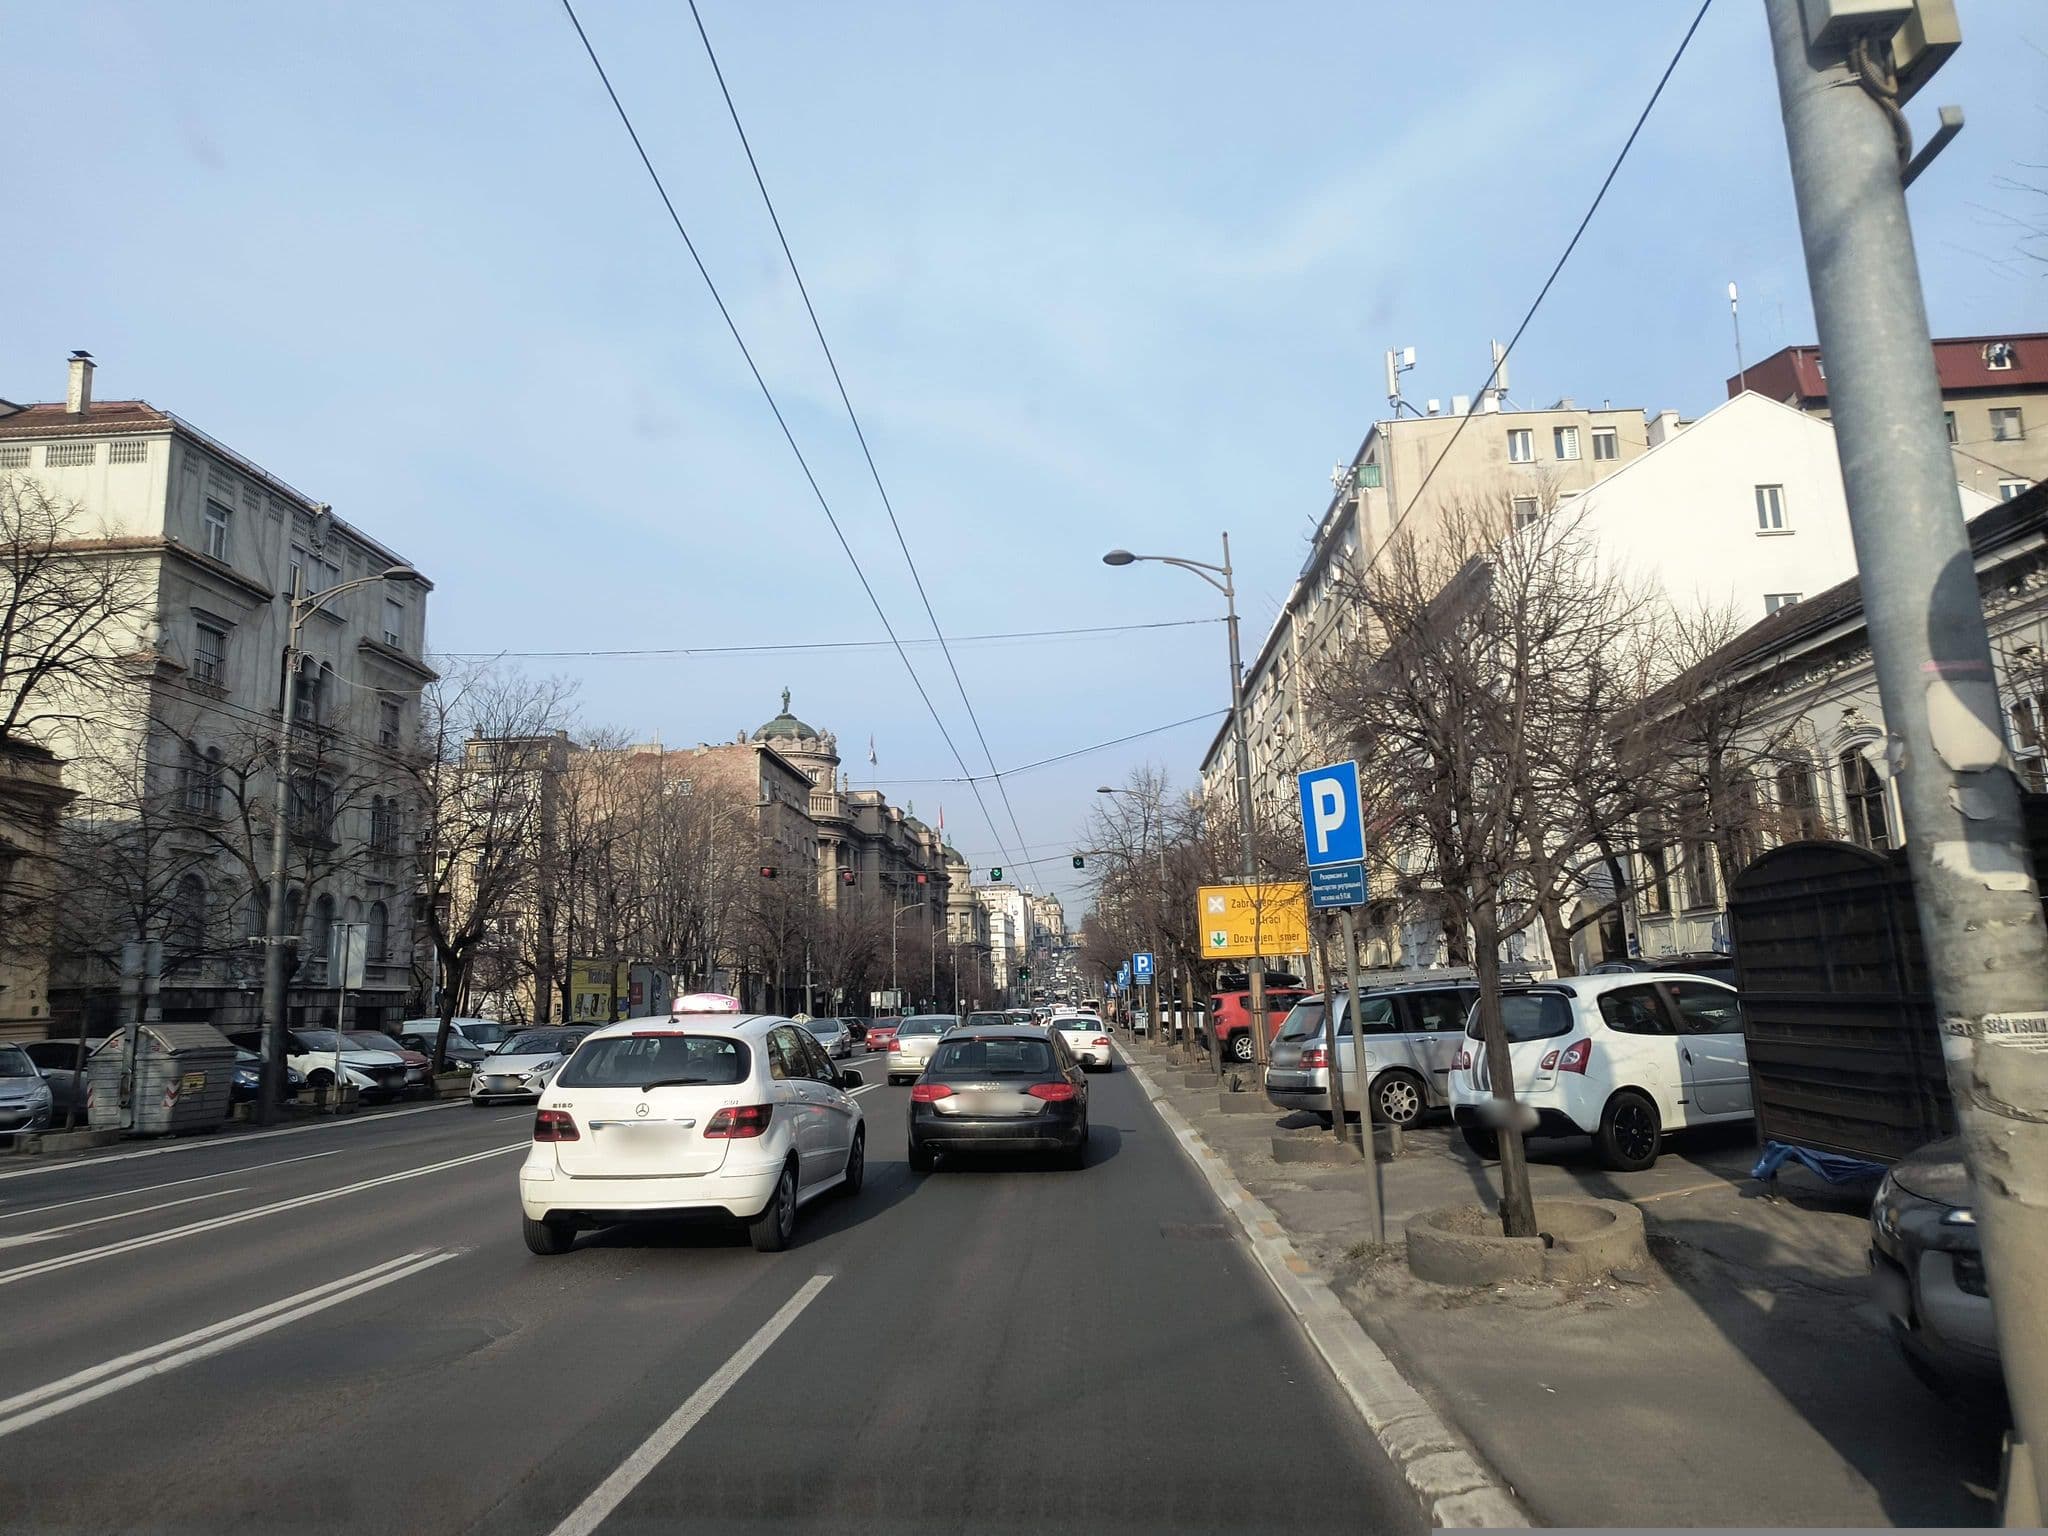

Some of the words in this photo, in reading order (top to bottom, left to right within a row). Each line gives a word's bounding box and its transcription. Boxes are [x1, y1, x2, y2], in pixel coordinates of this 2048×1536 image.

[1310, 778, 1346, 853] P
[1231, 898, 1272, 909] Zabraen
[1249, 917, 1255, 925] u
[1261, 915, 1281, 925] traci
[1233, 933, 1273, 945] Dozvjen
[1279, 932, 1300, 942] smer
[1137, 956, 1148, 972] P
[1119, 972, 1125, 983] P
